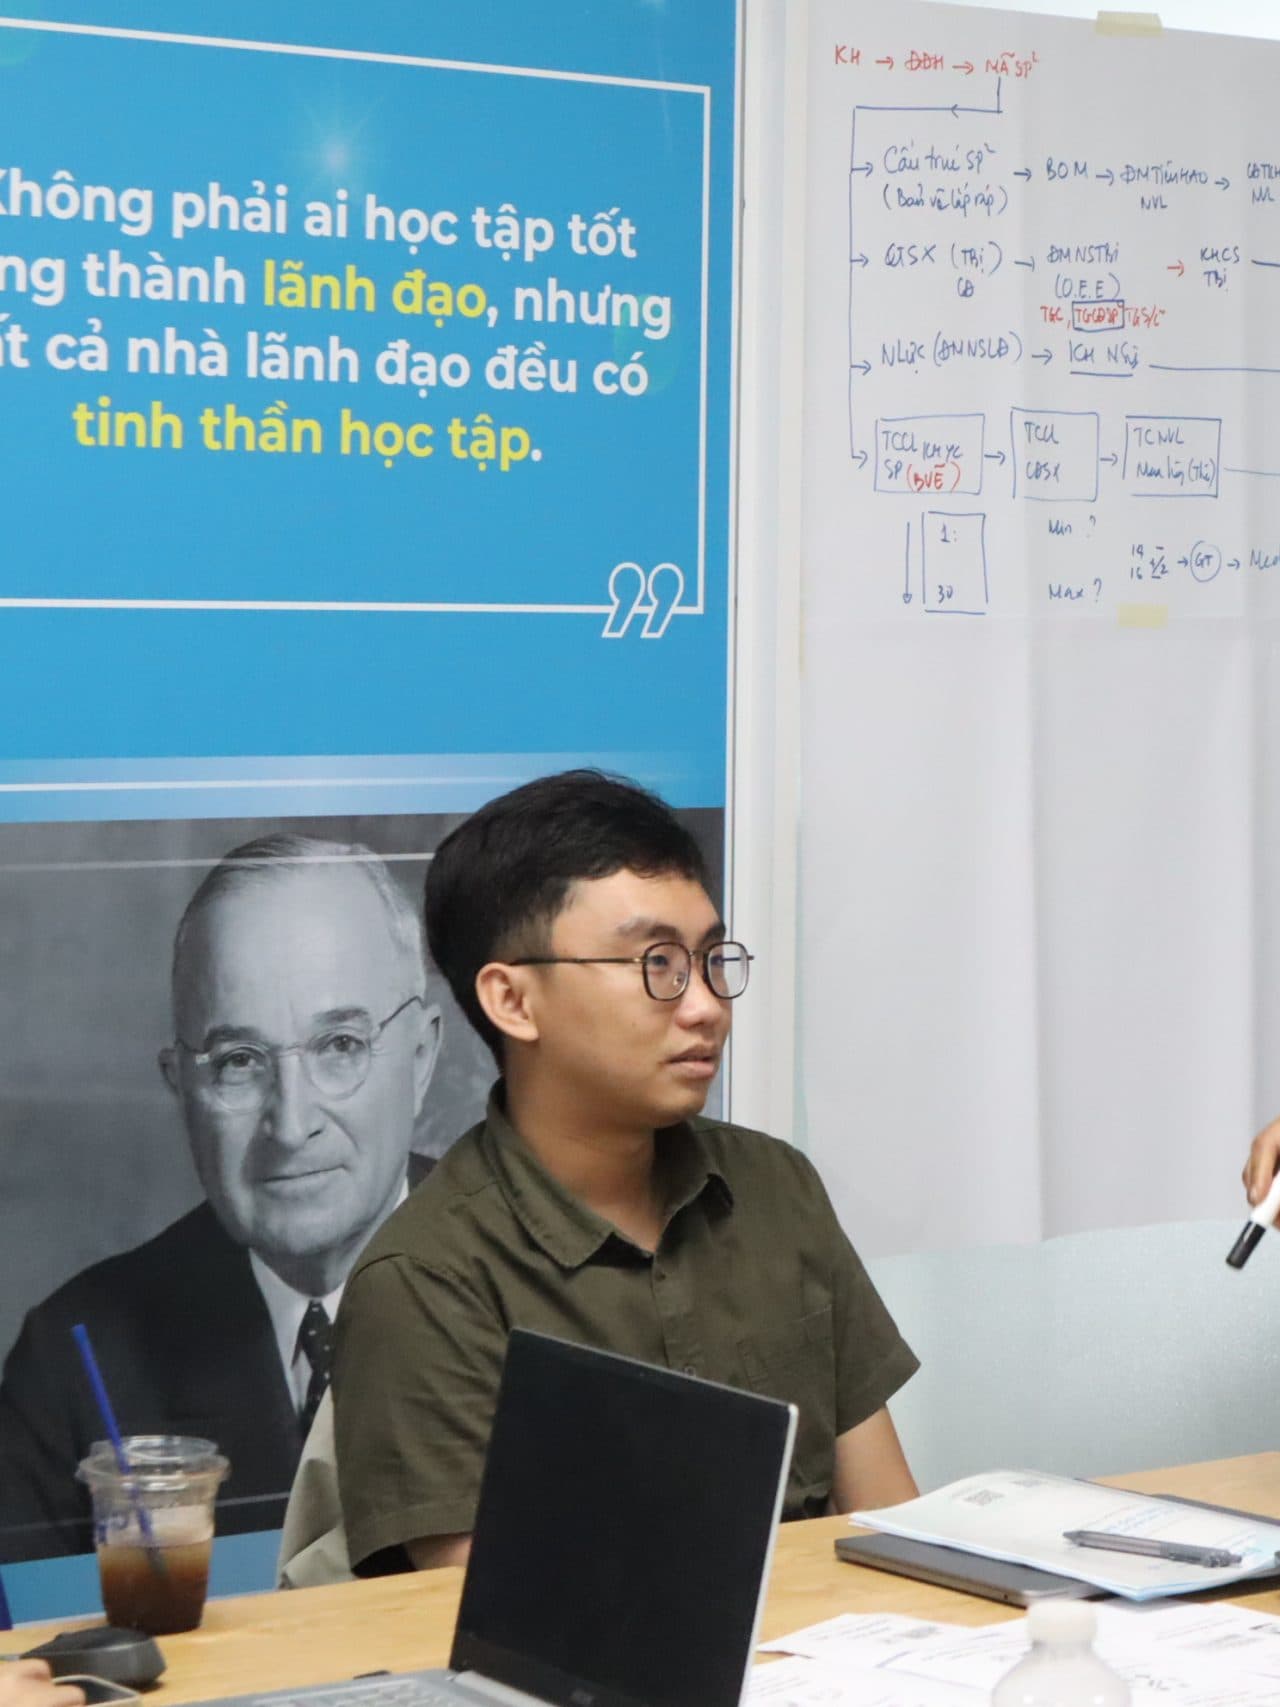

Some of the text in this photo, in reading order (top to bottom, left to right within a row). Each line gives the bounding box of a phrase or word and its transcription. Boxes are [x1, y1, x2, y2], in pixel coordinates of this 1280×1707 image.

[834, 45, 861, 66] KH
[1046, 156, 1089, 181] BOM
[172, 180, 288, 239] phải
[304, 190, 348, 238] ai
[365, 195, 457, 254] học
[472, 204, 554, 262] tập
[568, 208, 637, 258] tốt
[82, 250, 245, 304] thành
[263, 260, 375, 312] lãnh
[392, 269, 498, 327] đạo,
[513, 279, 671, 340] nhưng
[45, 318, 108, 372] cả
[127, 328, 228, 376] nhà
[247, 332, 358, 384] lãnh
[376, 340, 470, 398] đạo
[485, 342, 577, 394] đều
[593, 354, 648, 397] có
[72, 397, 543, 471] tinh thần học tập.
